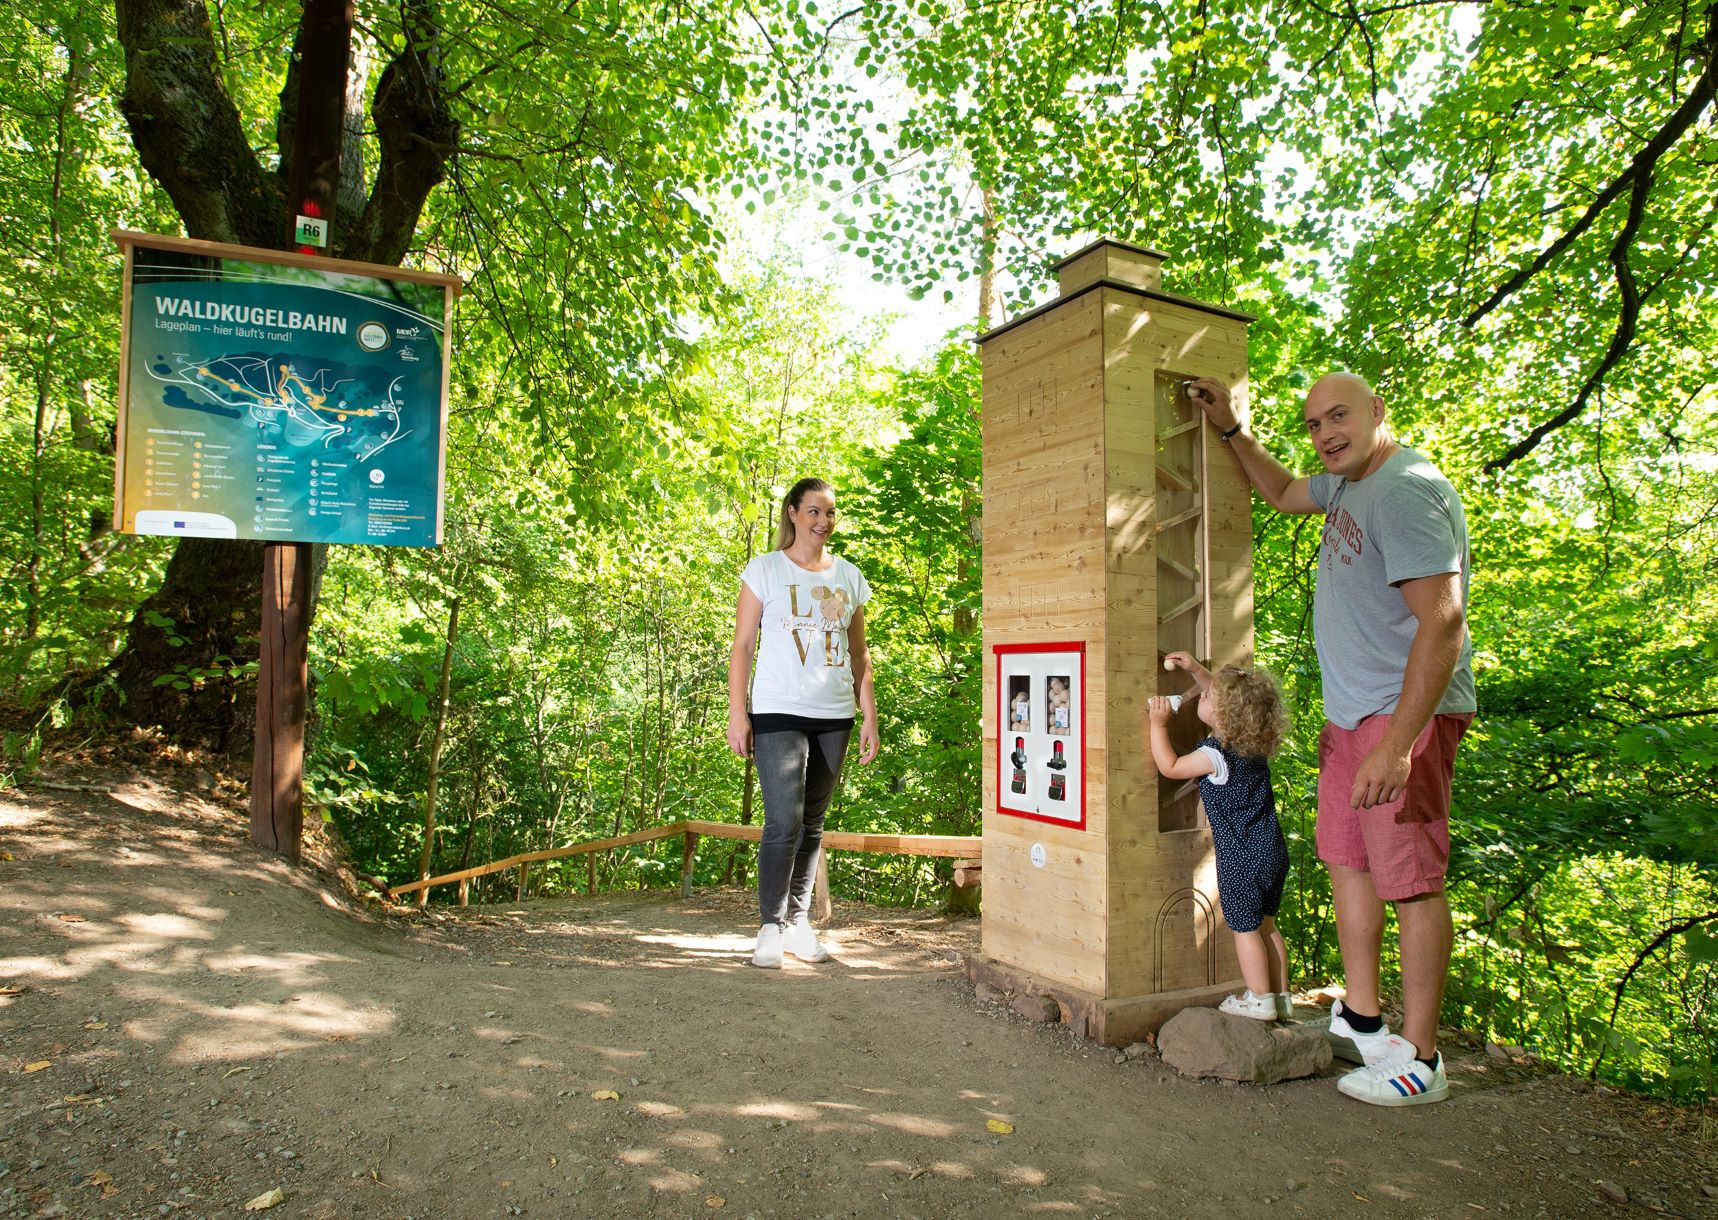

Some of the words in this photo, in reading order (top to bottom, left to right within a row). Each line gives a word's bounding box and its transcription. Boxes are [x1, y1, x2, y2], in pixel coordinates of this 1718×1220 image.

[303, 223, 320, 237] R6
[155, 296, 347, 335] WALDKUGELBAHN
[155, 318, 201, 333] Lageplan
[213, 324, 232, 336] hier
[267, 332, 292, 342] rund!
